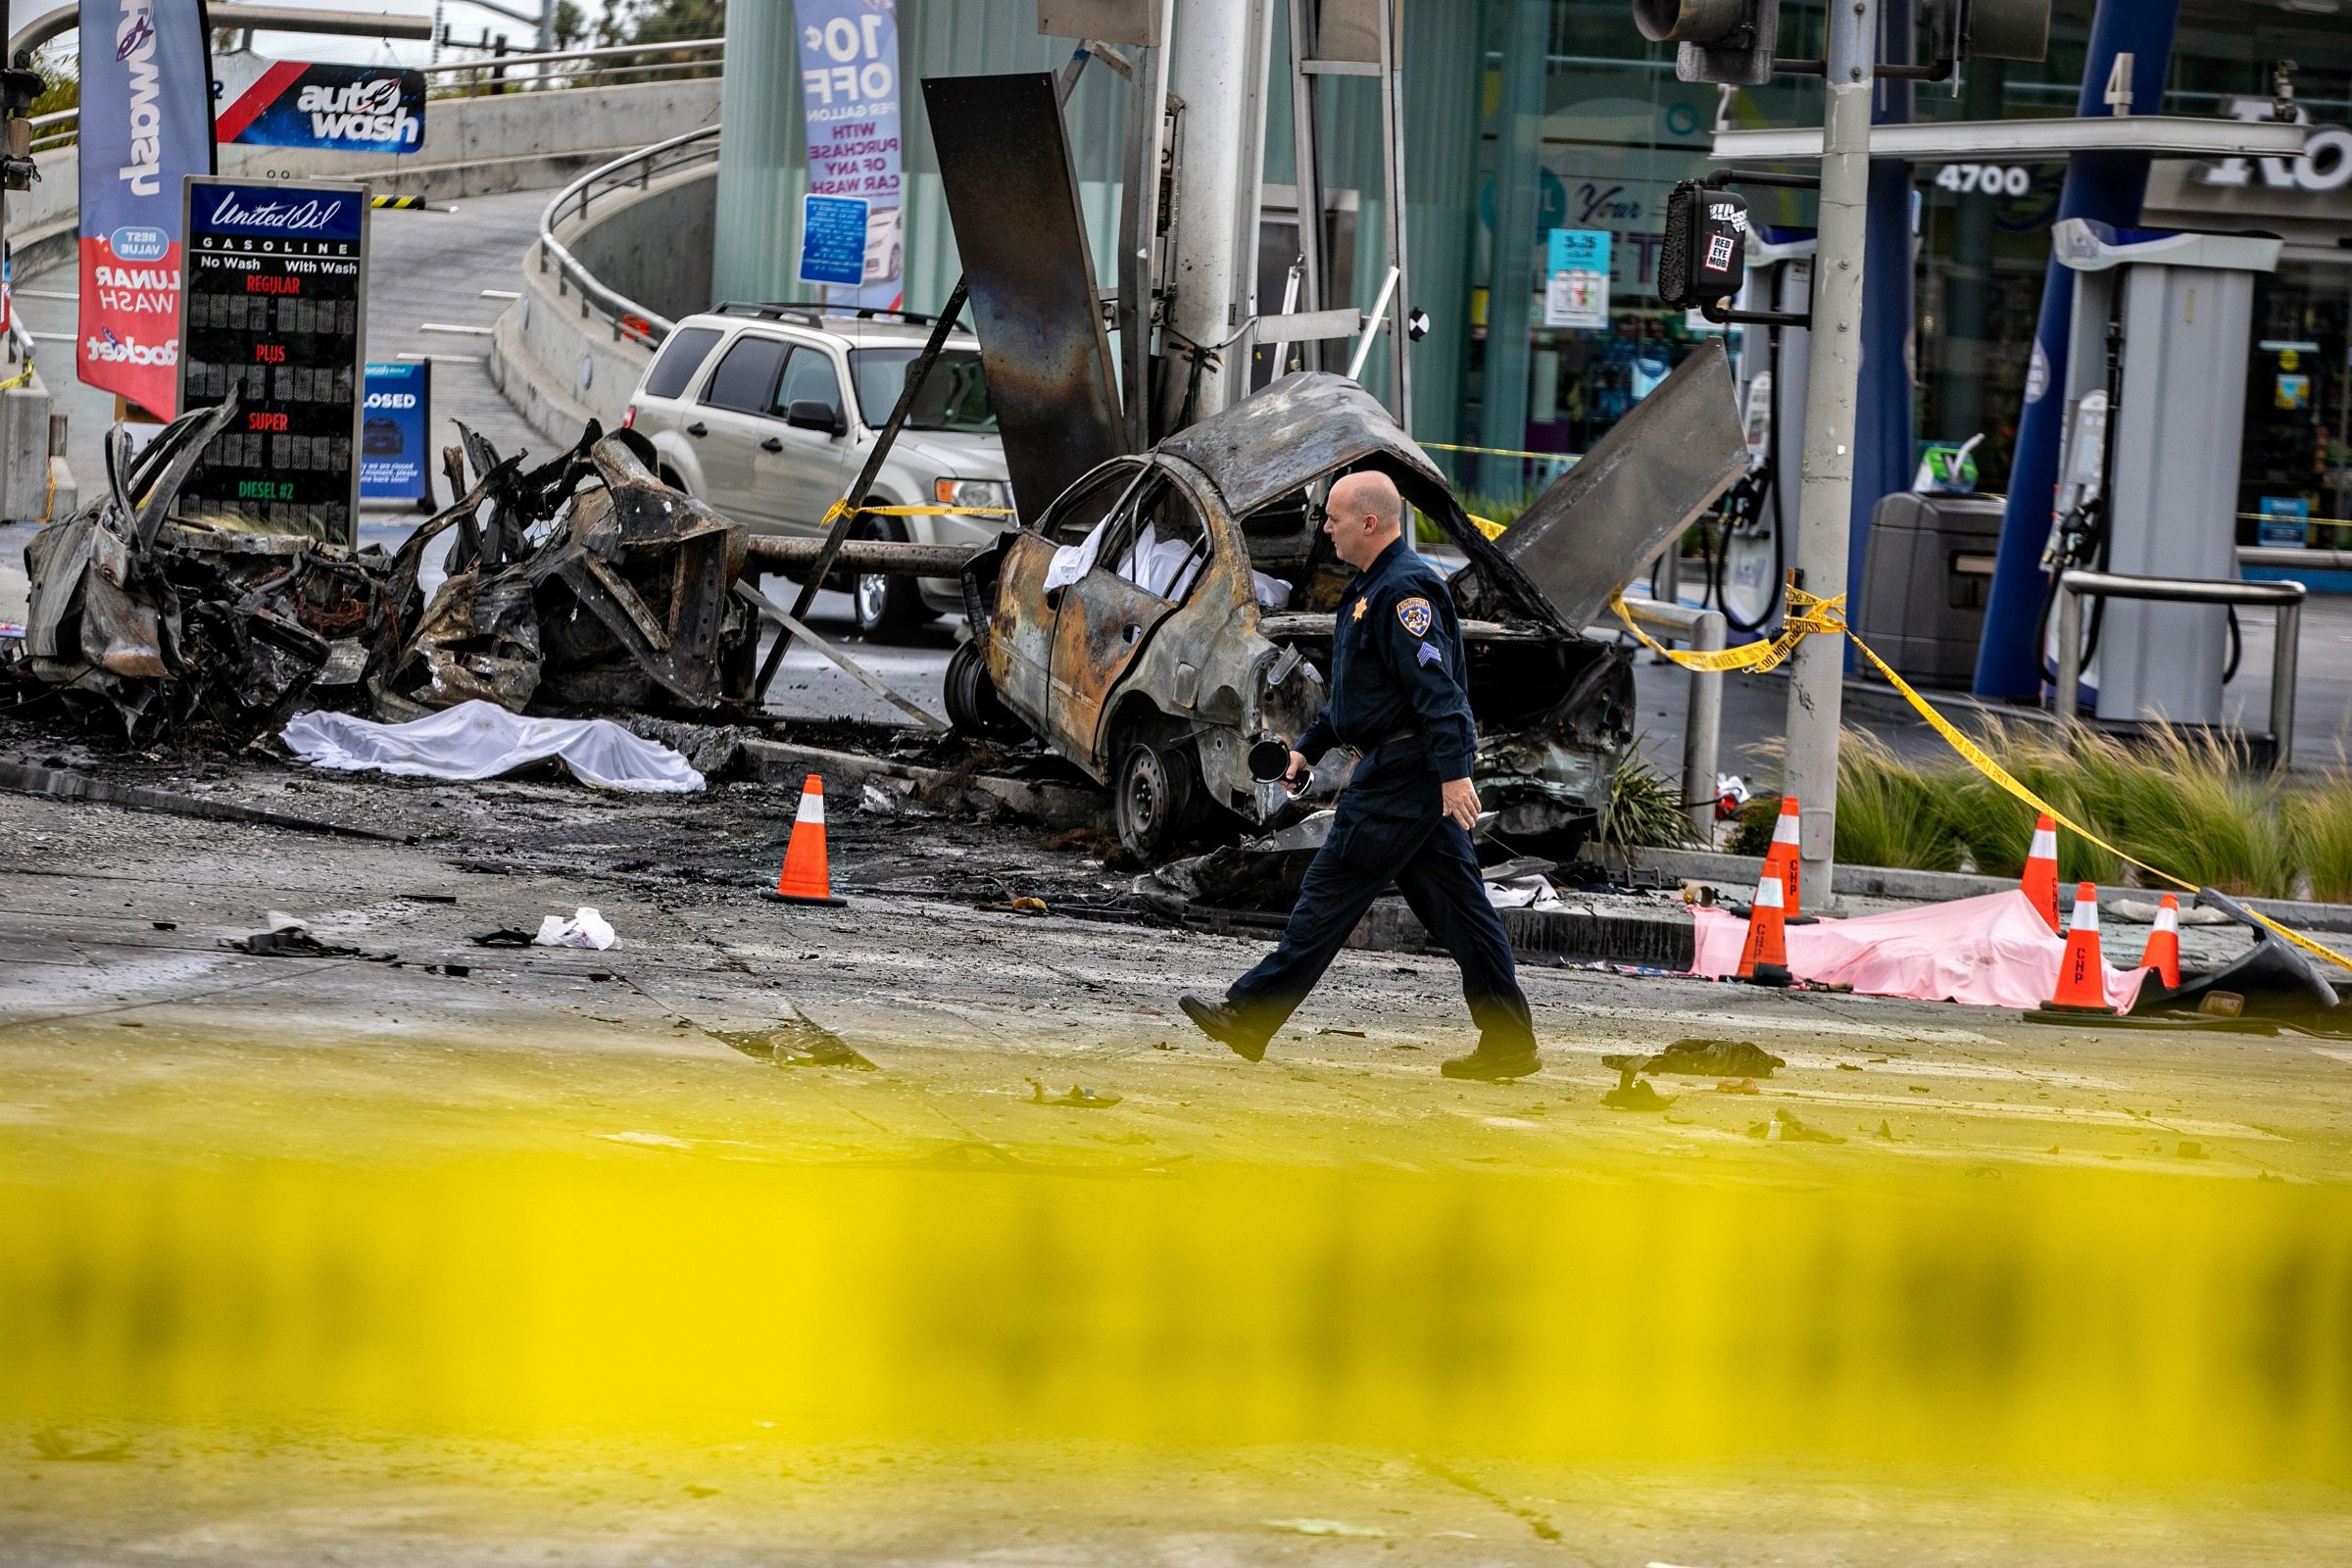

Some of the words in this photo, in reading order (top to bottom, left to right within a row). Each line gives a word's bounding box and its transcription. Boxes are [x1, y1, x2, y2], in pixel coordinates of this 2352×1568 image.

[2104, 53, 2134, 117] 4
[297, 78, 401, 115] auto
[312, 107, 419, 144] wash
[1936, 165, 2030, 196] 4700
[211, 191, 296, 227] United
[287, 200, 341, 229] Oil
[203, 237, 348, 255] GASOLINE
[1714, 237, 1731, 249] RED
[1708, 256, 1727, 269] MOB
[1712, 247, 1728, 259] EYE
[201, 256, 220, 269] No
[223, 257, 261, 270] Wash
[284, 261, 317, 273] With
[320, 262, 357, 274] Wash
[247, 274, 300, 294] REGULAR
[256, 345, 285, 362] PLUS
[249, 413, 288, 431] SUPER
[239, 481, 276, 499] DIESEL
[279, 483, 294, 499] #2
[1773, 640, 1790, 660] NOT
[1753, 923, 1765, 958] CHP
[2075, 948, 2085, 984] CHP
